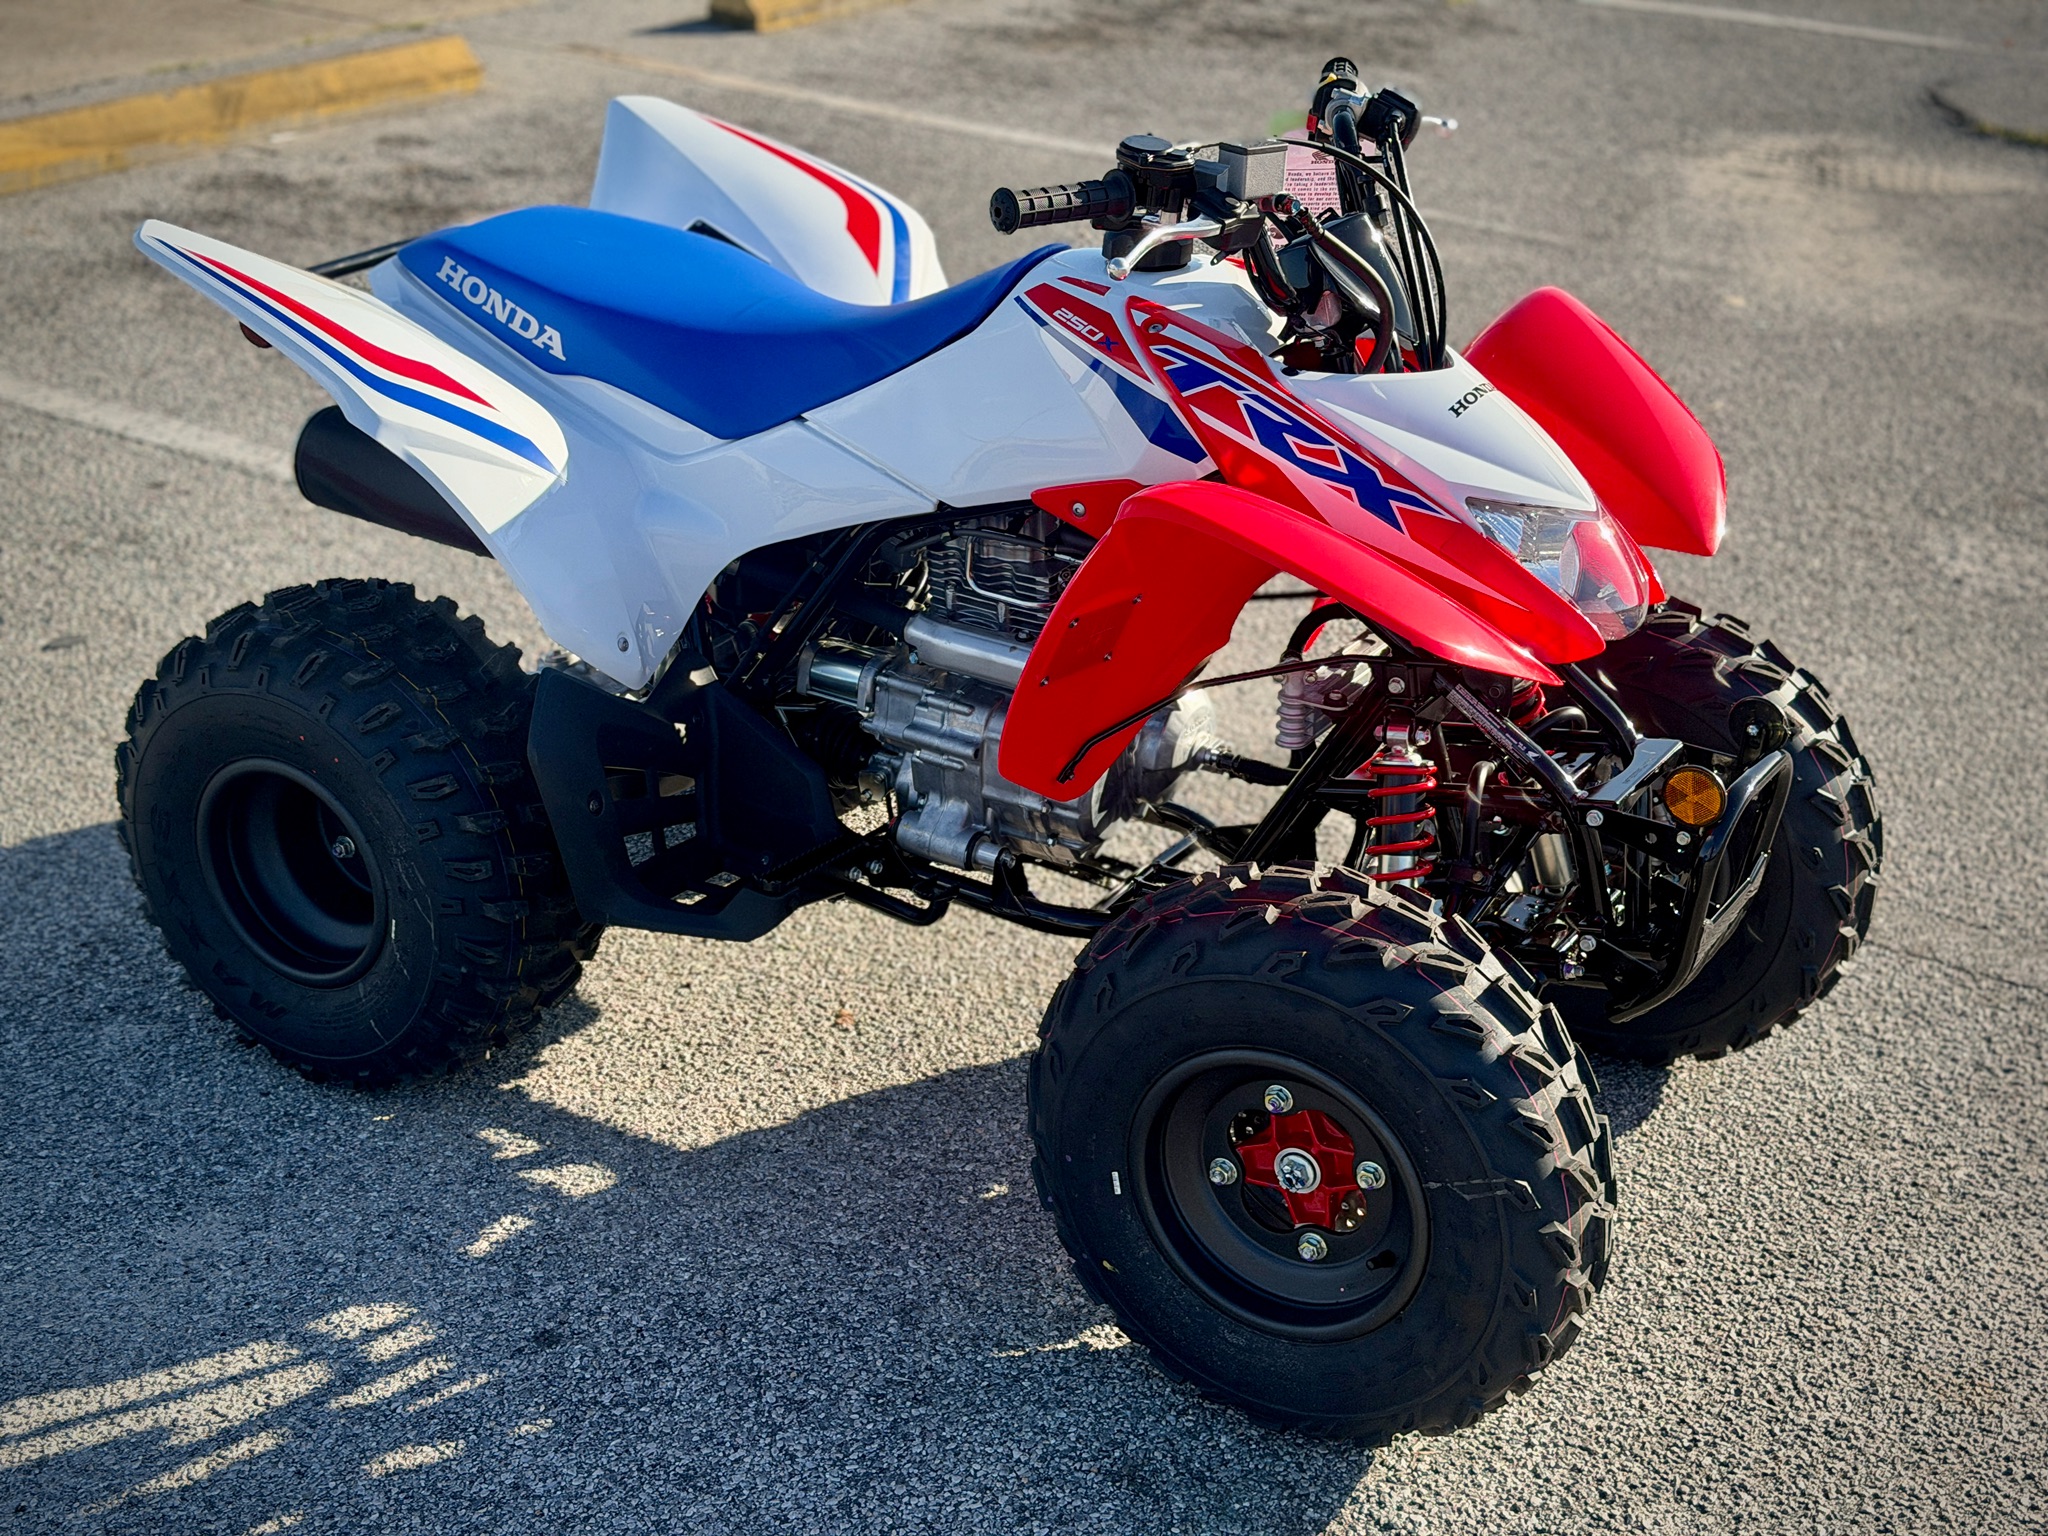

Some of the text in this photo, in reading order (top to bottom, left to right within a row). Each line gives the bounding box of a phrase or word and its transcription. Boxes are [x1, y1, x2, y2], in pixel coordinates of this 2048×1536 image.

[435, 255, 567, 362] HONDA
[1150, 345, 1458, 535] TRX
[1448, 383, 1495, 418] HOND
